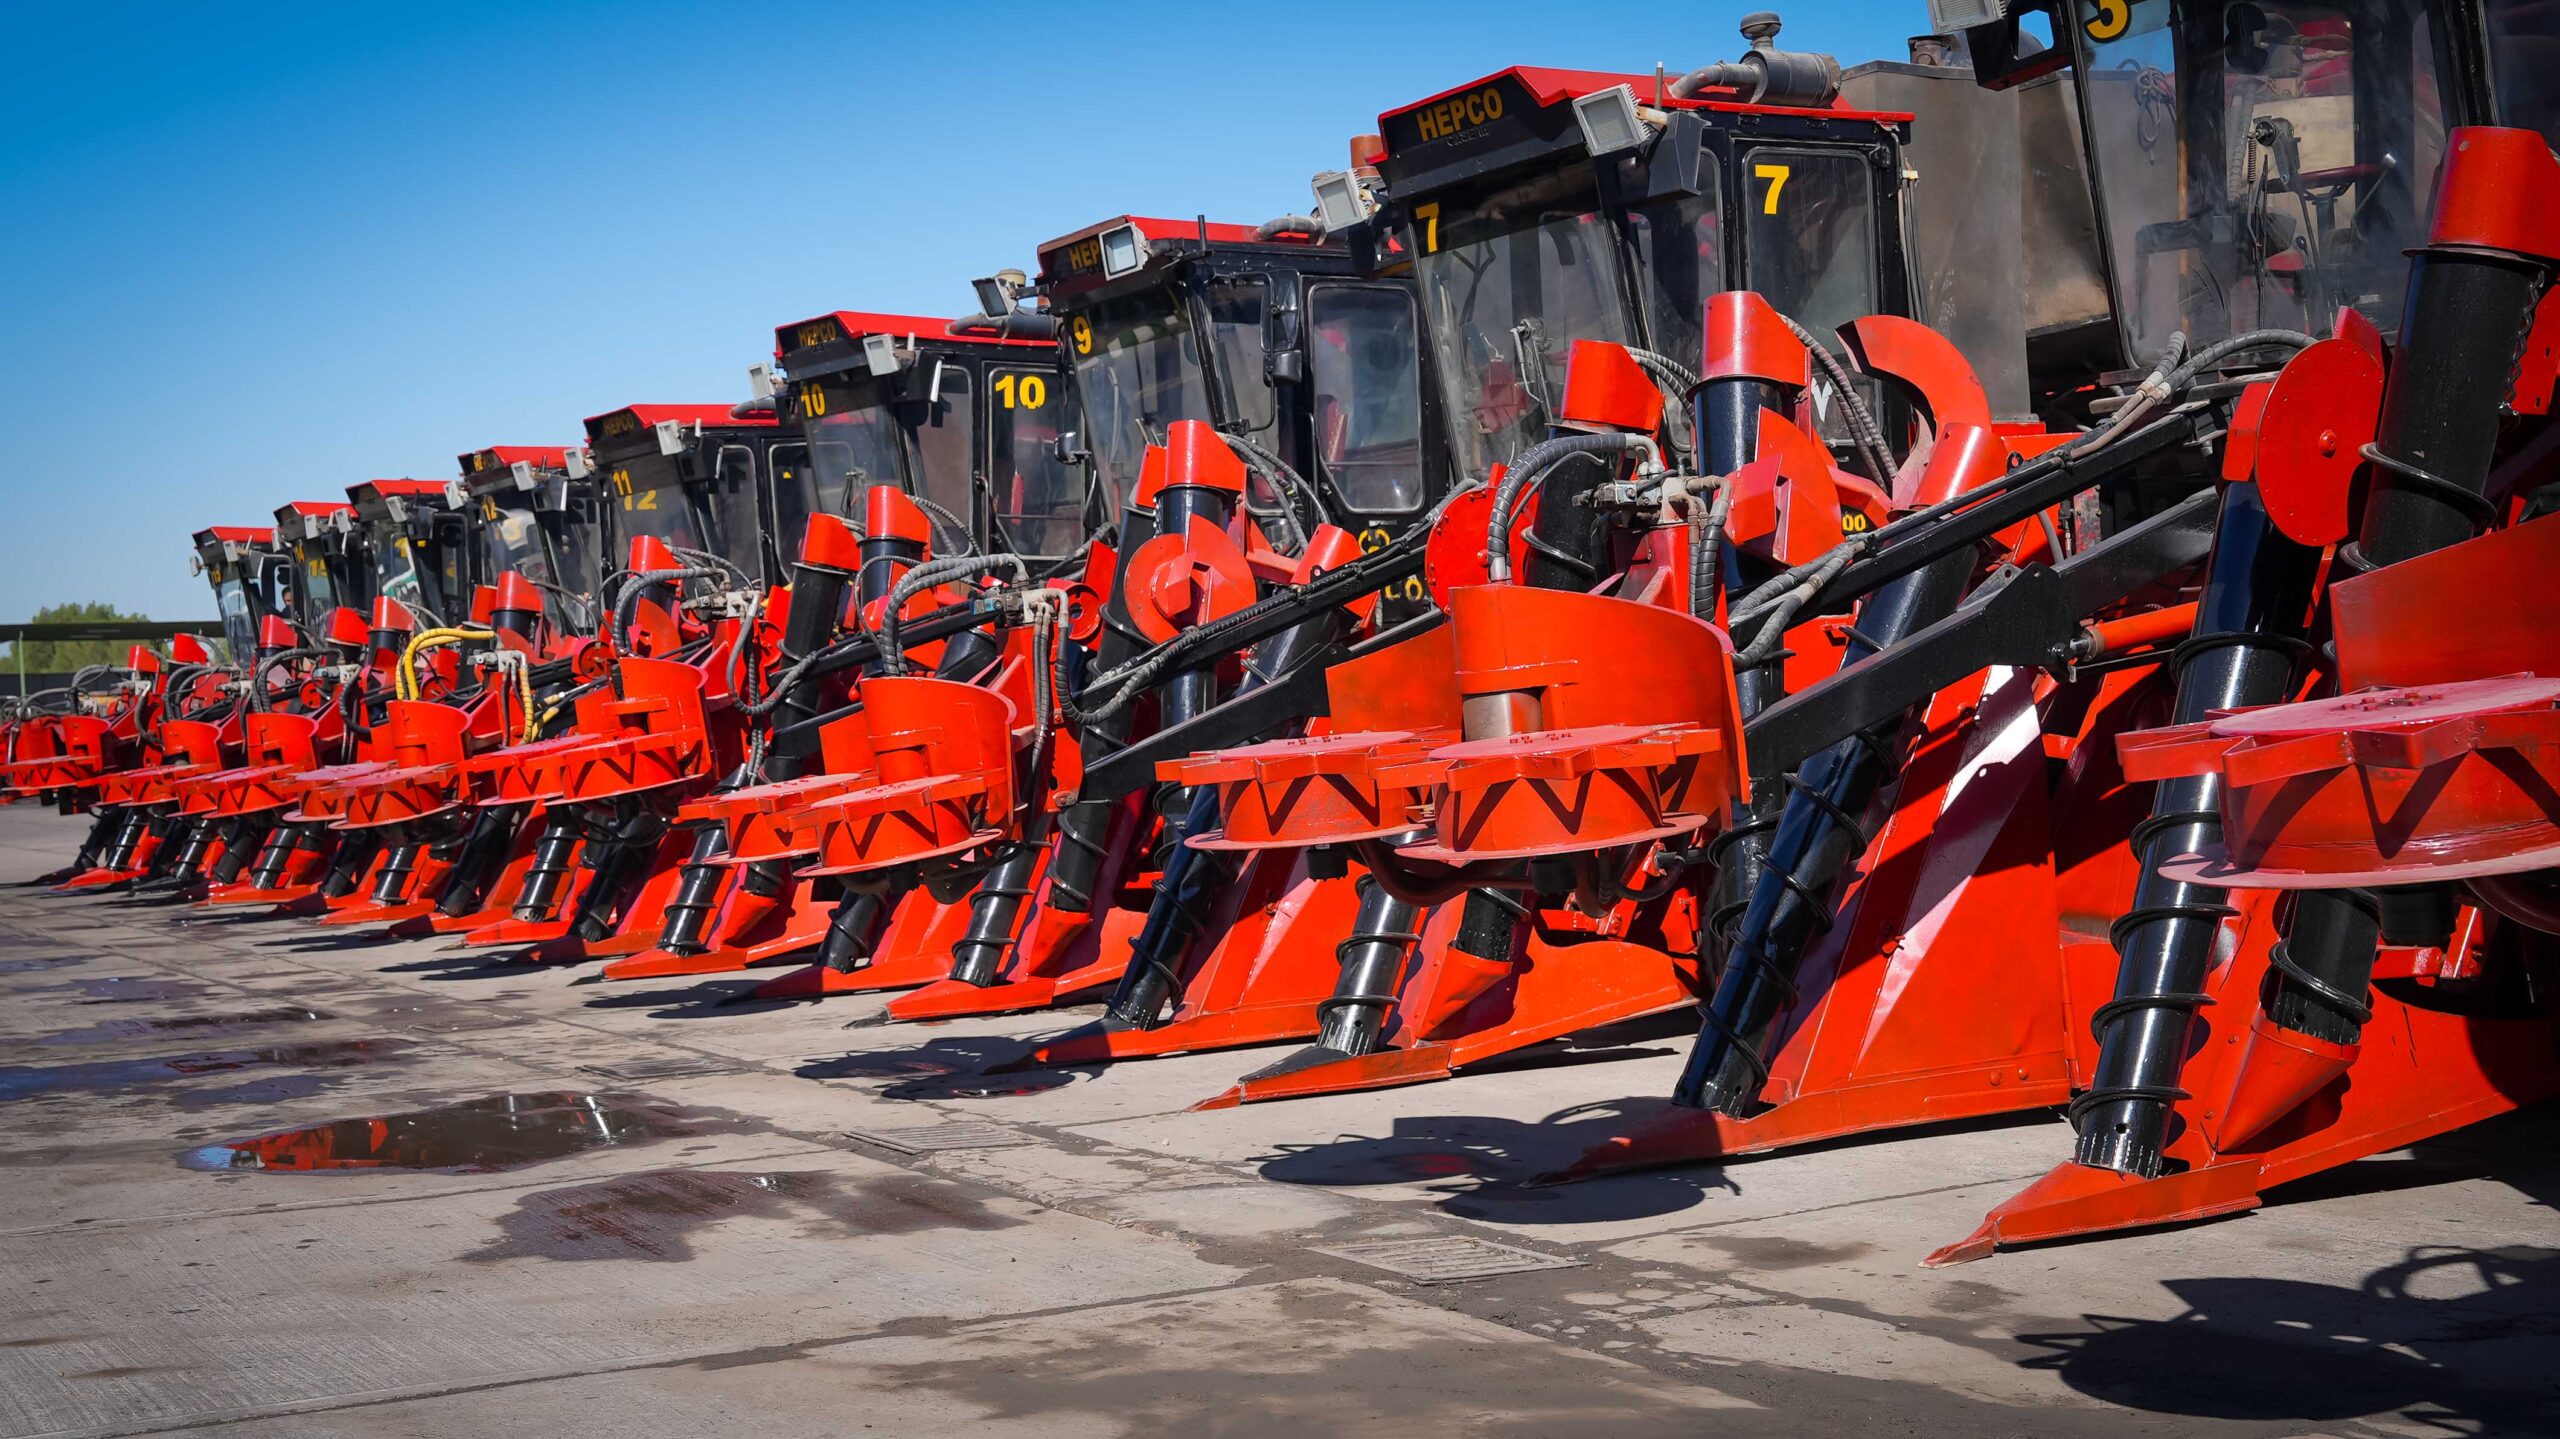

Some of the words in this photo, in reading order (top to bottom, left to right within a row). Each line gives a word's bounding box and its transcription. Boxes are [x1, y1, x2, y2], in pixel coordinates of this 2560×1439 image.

[1416, 88, 1503, 142] HEPCO
[1755, 164, 1789, 215] 7
[1415, 202, 1439, 253] 7
[1069, 240, 1100, 270] HEP
[1073, 315, 1092, 355] 9
[801, 384, 826, 417] 10
[995, 375, 1046, 410] 10
[612, 470, 632, 496] 11
